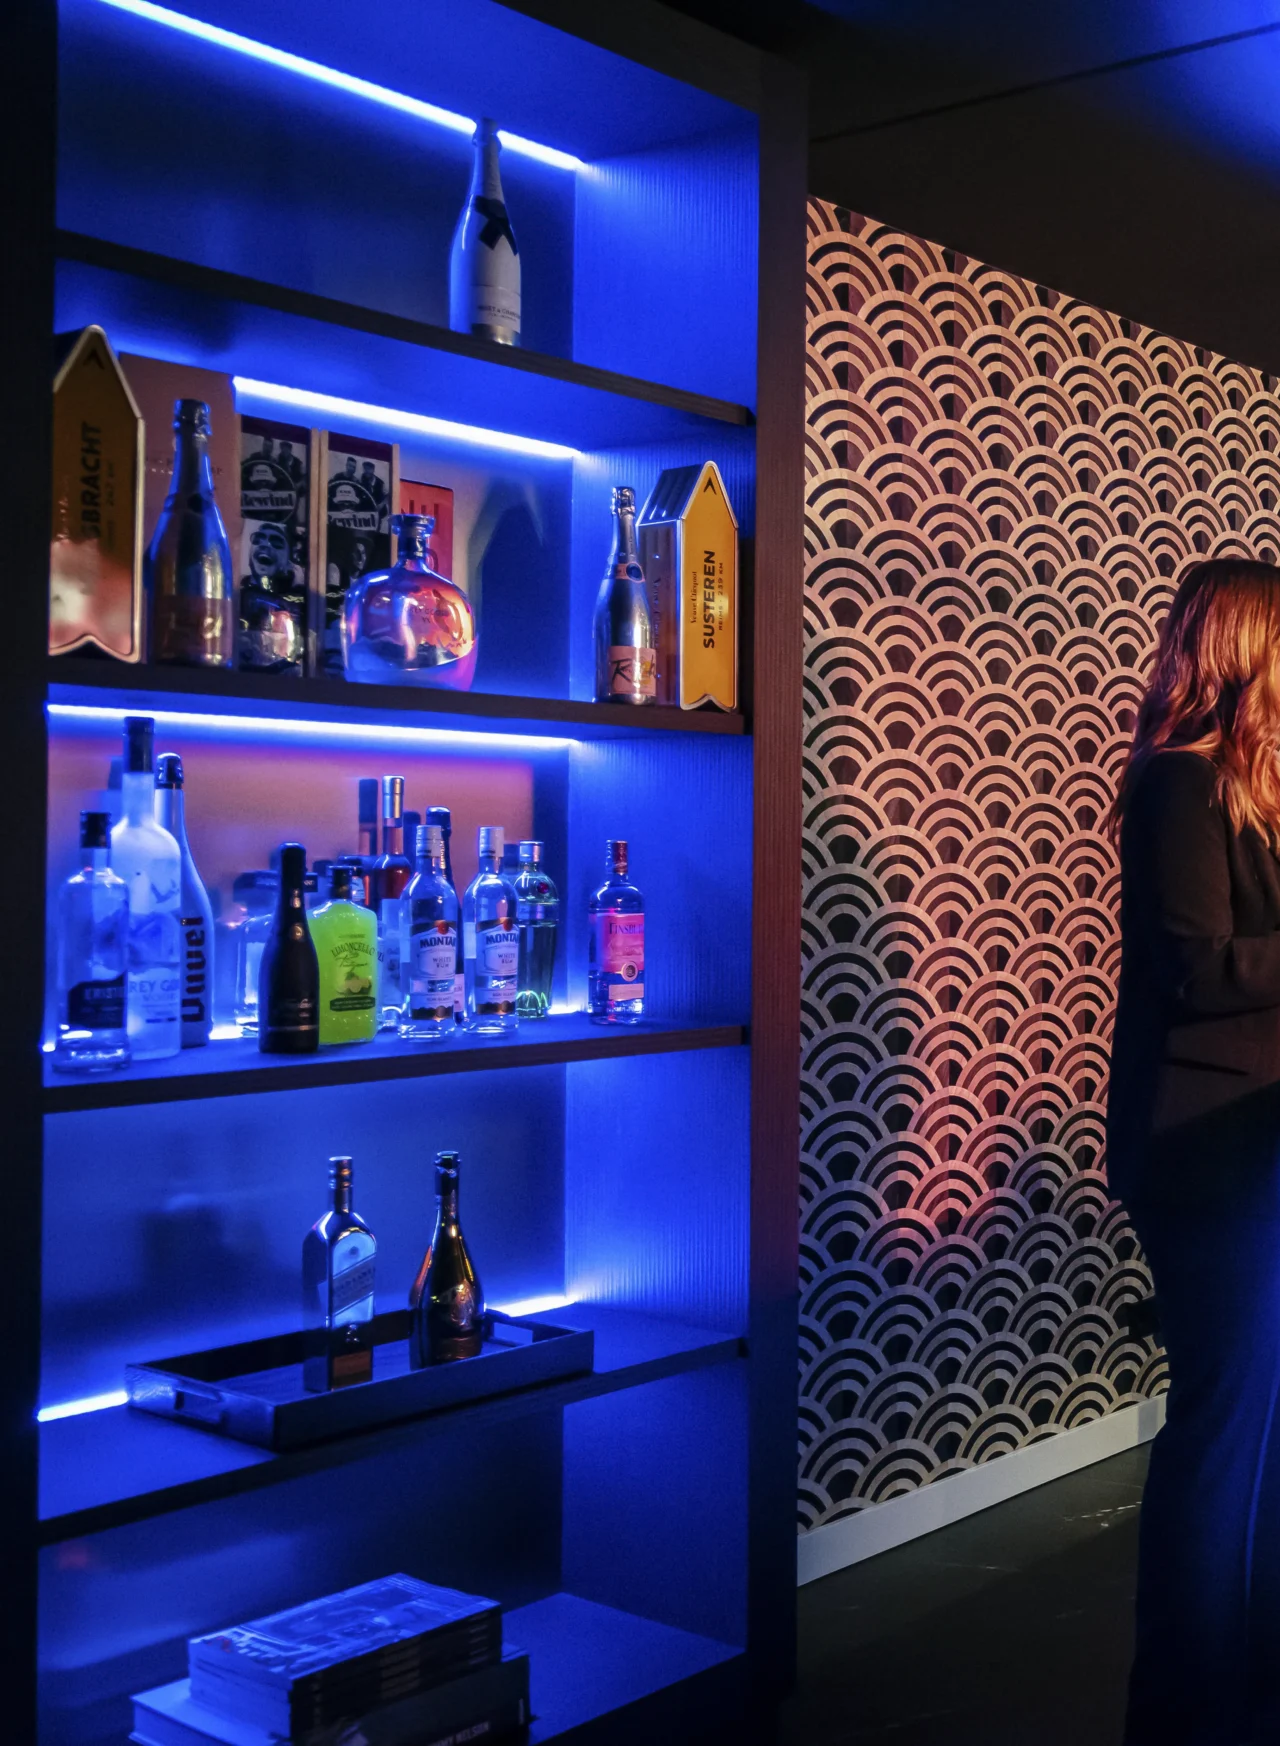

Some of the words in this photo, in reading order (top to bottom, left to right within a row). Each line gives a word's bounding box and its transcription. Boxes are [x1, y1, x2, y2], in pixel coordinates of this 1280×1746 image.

[718, 562, 723, 575] KM
[703, 550, 716, 649] SUSTEREN
[331, 941, 376, 958] LIMONCELLO
[129, 979, 156, 993] REY
